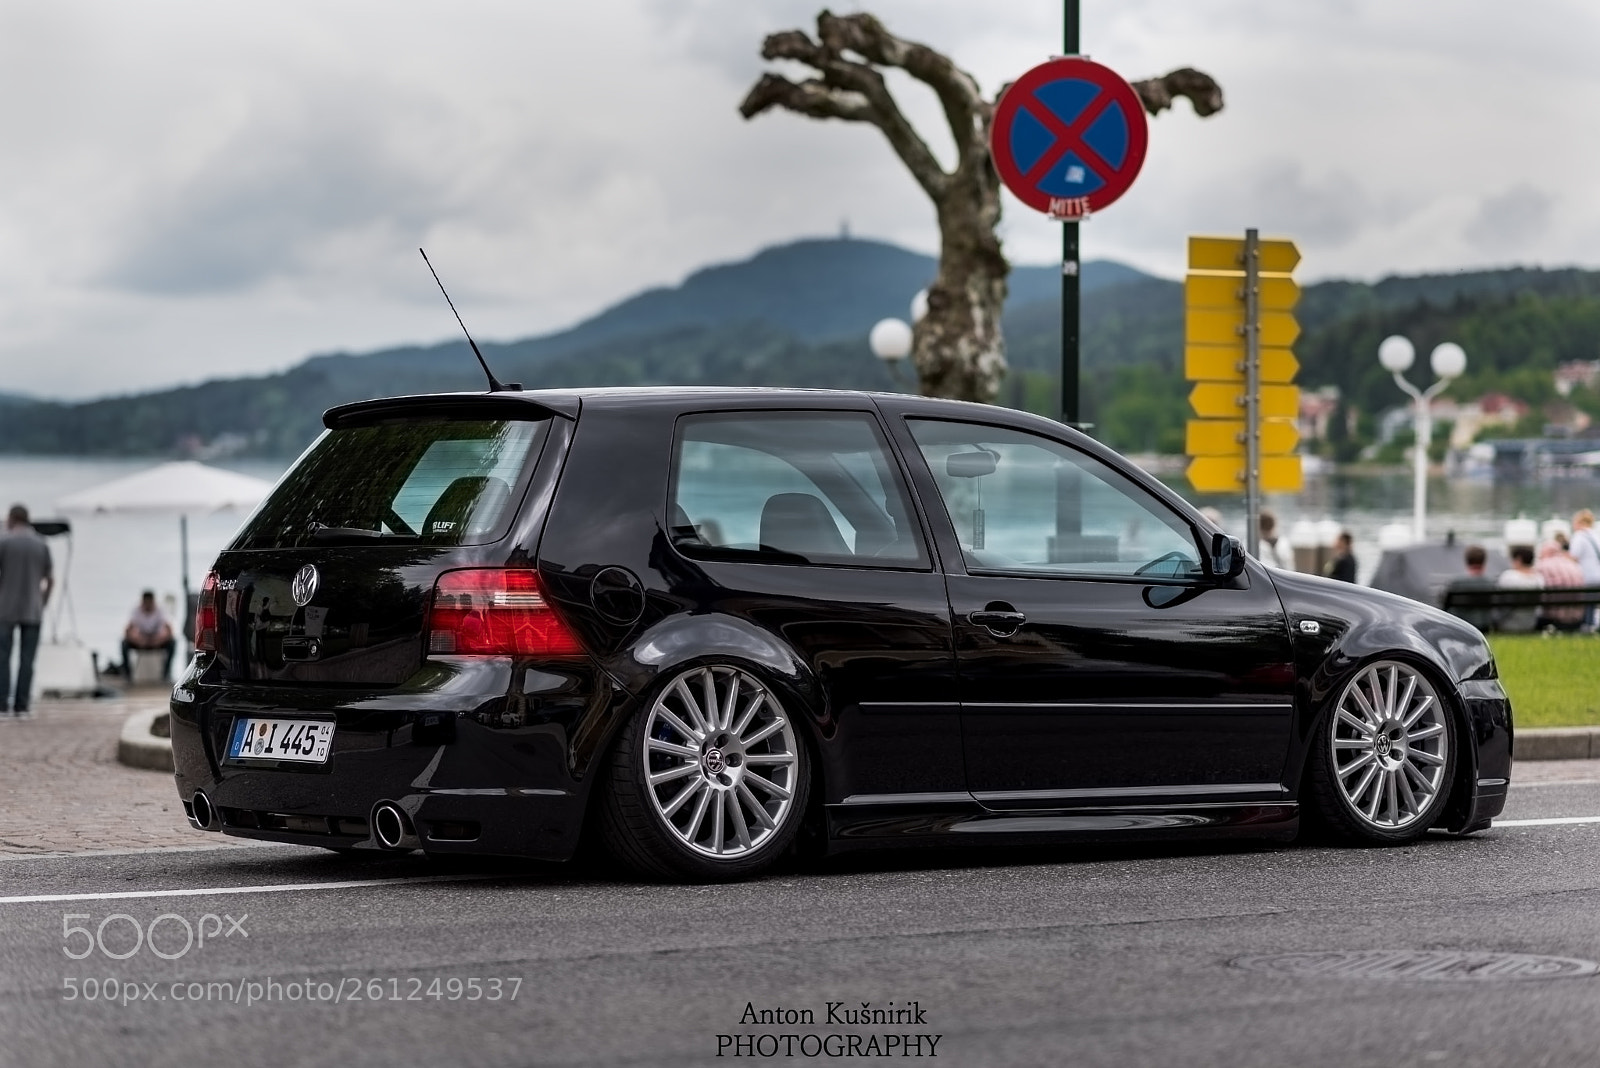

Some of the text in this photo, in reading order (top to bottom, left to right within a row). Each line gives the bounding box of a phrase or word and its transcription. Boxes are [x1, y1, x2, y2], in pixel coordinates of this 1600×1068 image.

[1049, 196, 1091, 216] MITTE
[241, 723, 256, 753] A
[280, 724, 319, 756] 445
